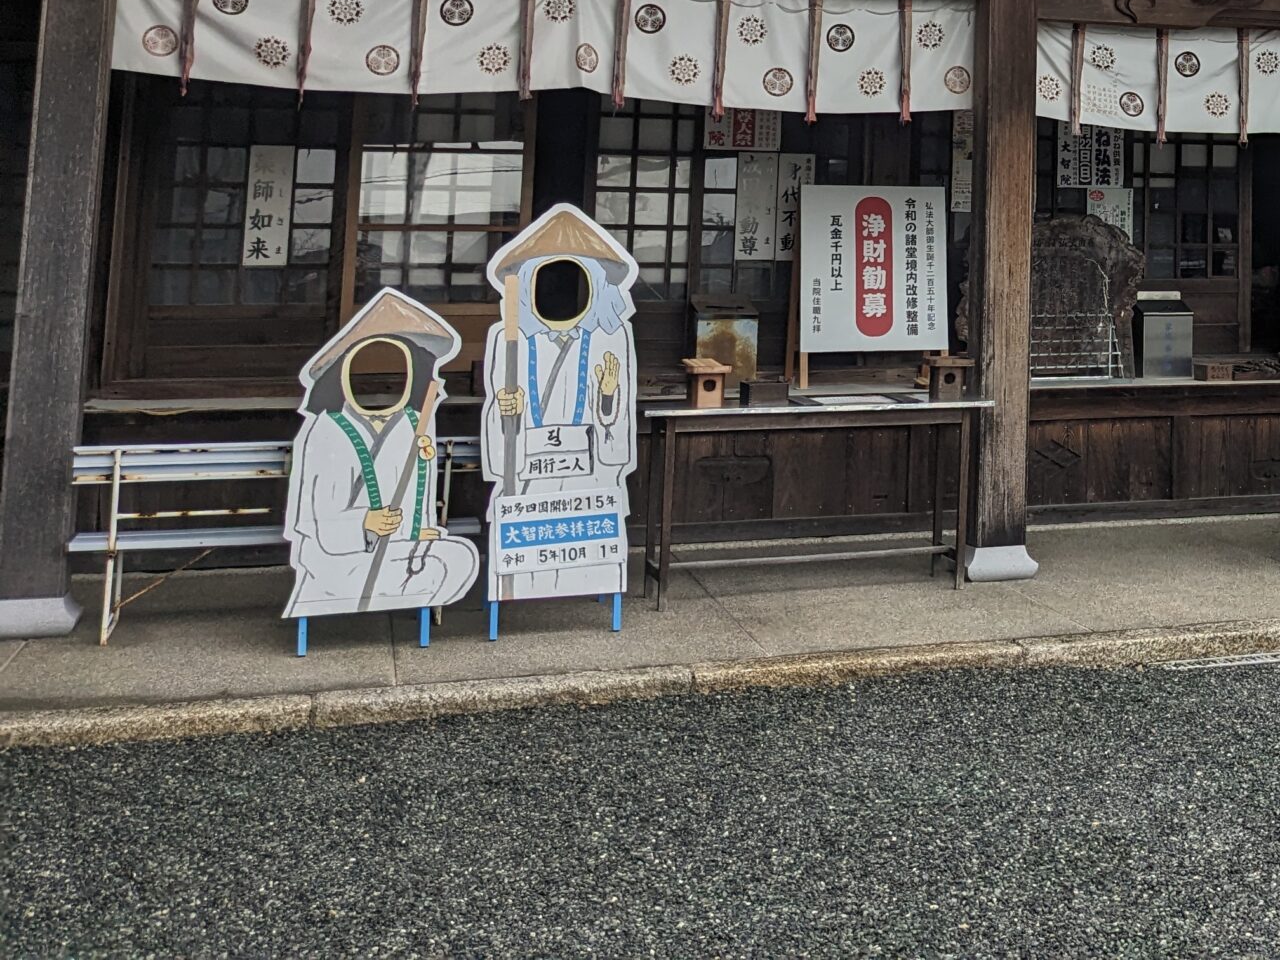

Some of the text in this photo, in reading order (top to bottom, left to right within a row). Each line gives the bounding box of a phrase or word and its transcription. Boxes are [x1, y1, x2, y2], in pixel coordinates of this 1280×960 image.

[1060, 141, 1072, 186] 大智院
[830, 214, 843, 292] 瓦金千円以上
[861, 213, 887, 318] 浄財勧募
[904, 197, 919, 336] 令和の諸堂境内改修整備
[812, 278, 821, 334] 当院住職九拝
[528, 457, 585, 475] 同行二人
[504, 518, 616, 544] 大智院参拝記念
[502, 552, 525, 568] 令和
